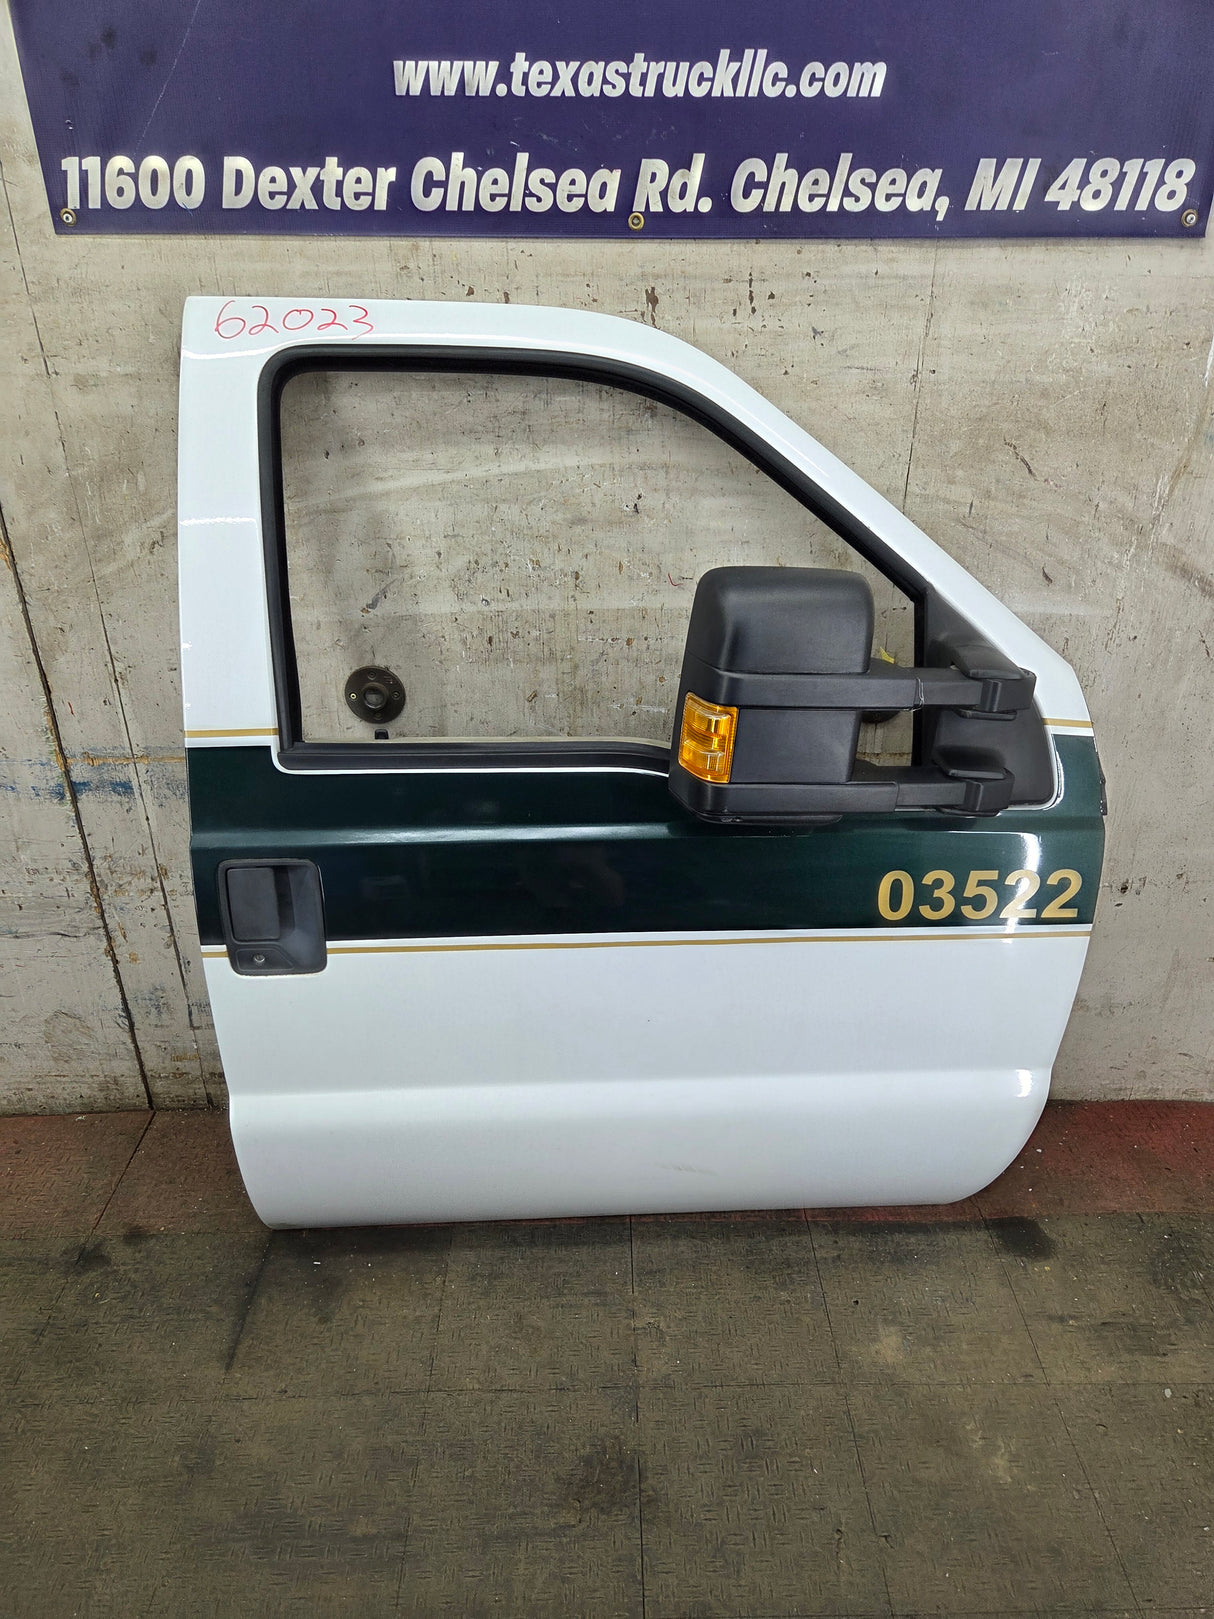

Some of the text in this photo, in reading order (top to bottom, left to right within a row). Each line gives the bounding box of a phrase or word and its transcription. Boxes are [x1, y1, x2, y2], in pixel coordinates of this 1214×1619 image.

[393, 48, 888, 99] www.texastruckllc.com
[60, 151, 1197, 222] 11600 Dexter Chelsea Rd. Chelsea, MI 48118
[214, 299, 375, 341] 62023
[877, 868, 1083, 921] 03522
